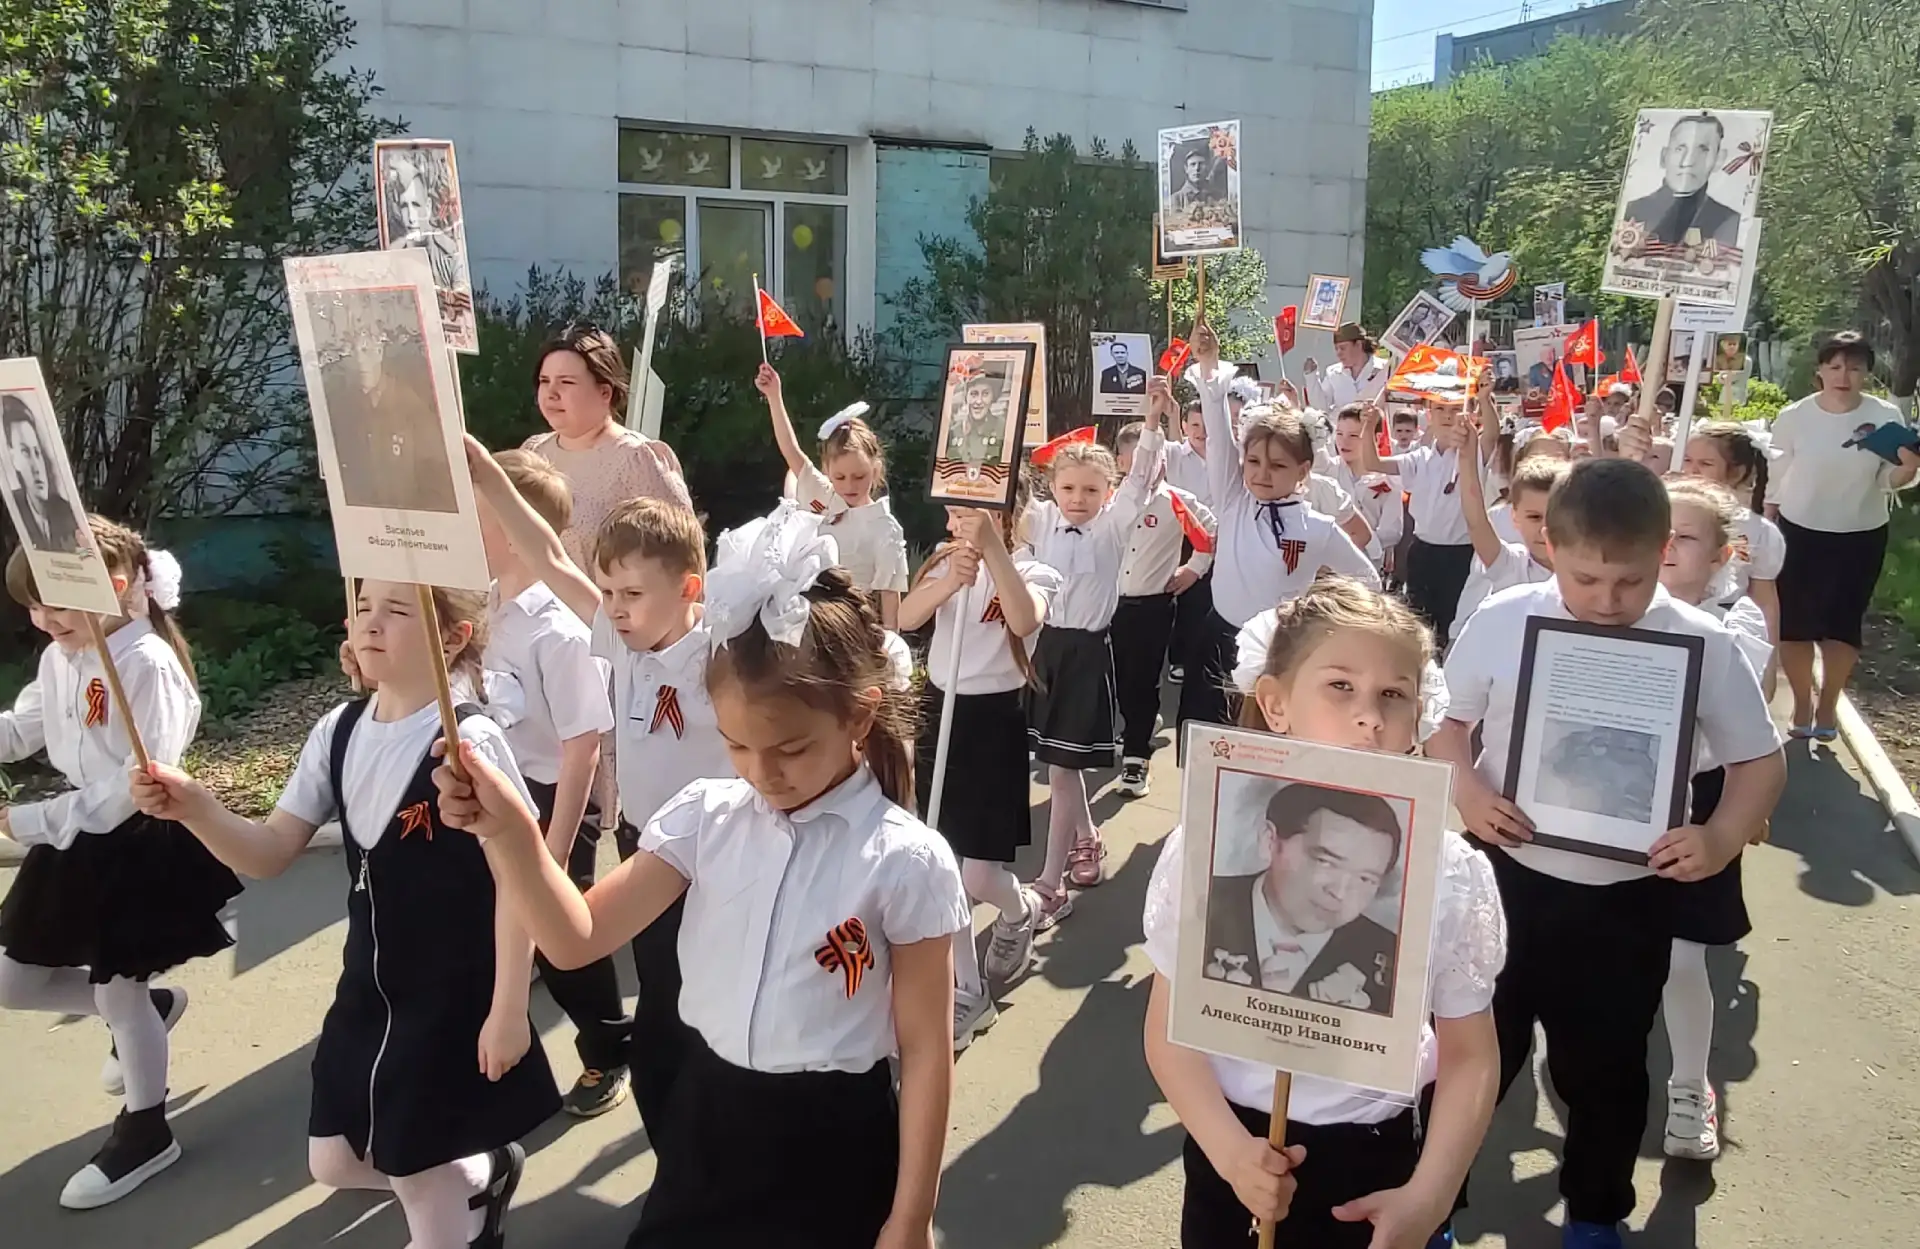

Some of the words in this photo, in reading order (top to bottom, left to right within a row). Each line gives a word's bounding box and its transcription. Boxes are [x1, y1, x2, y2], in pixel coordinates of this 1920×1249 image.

[385, 524, 425, 536] Васильев
[1246, 996, 1341, 1028] Конышков
[1201, 1003, 1293, 1037] Александр
[1297, 1025, 1387, 1055] Иванович
